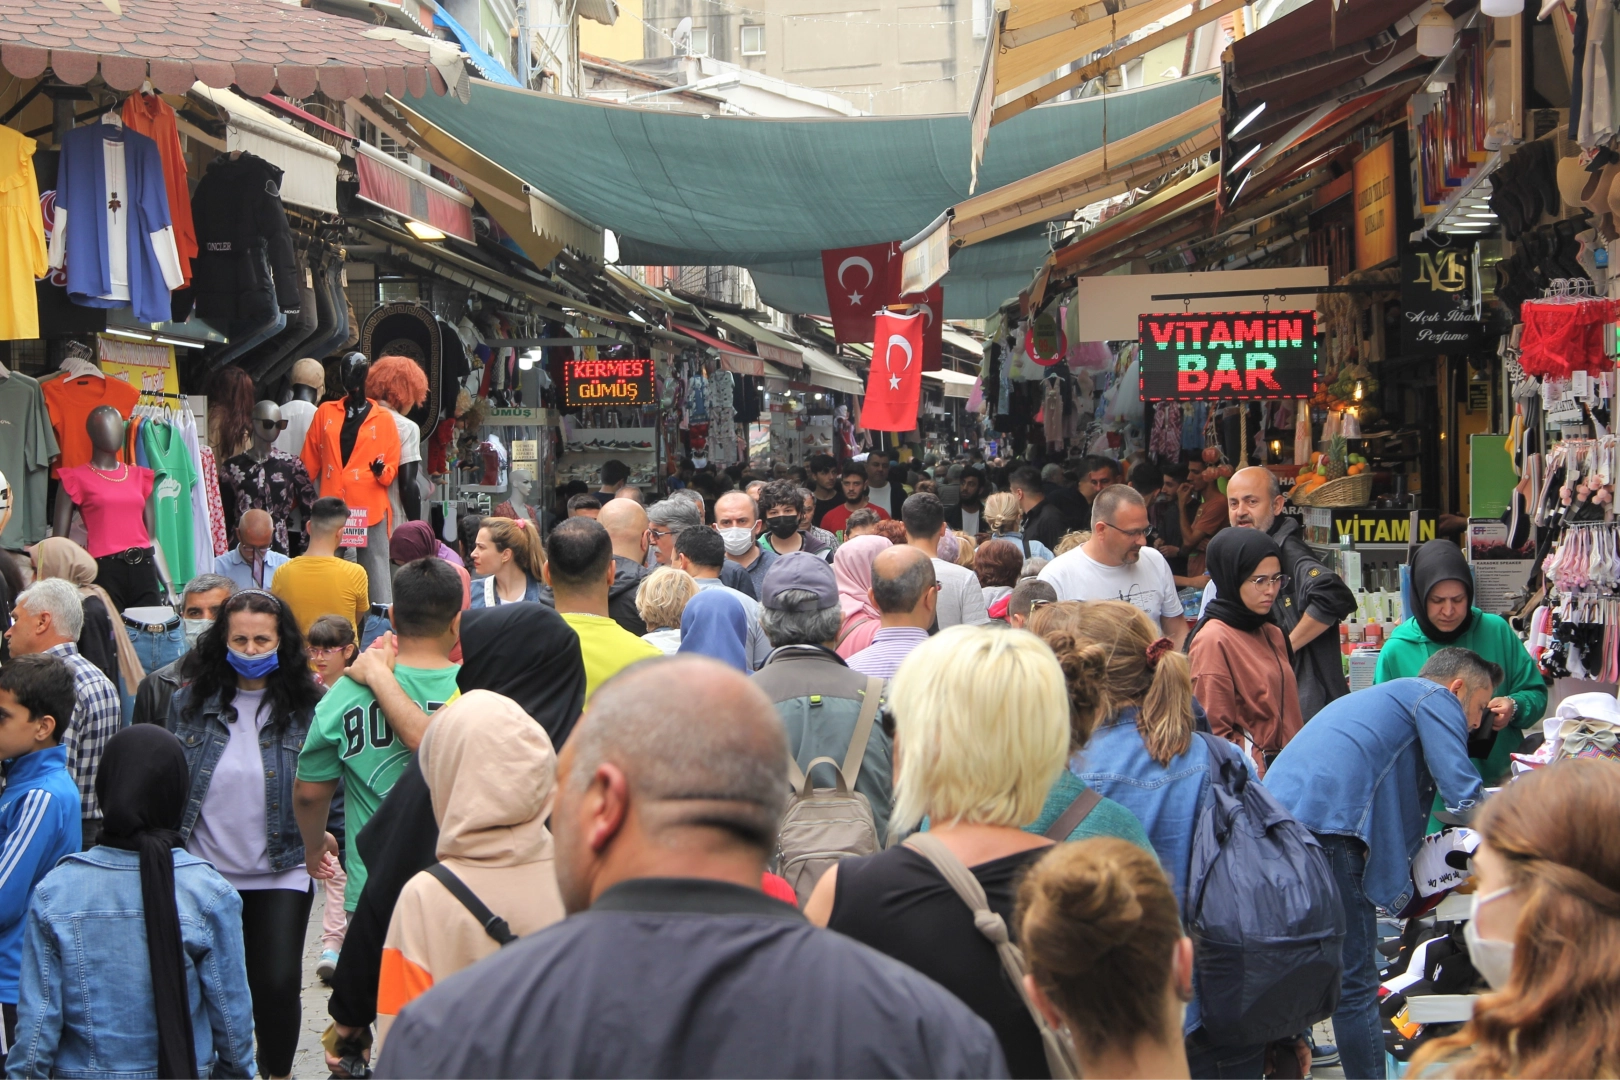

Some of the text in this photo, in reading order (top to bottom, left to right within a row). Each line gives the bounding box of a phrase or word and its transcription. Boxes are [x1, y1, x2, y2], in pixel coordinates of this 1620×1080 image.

[1416, 329, 1469, 344] Perfume
[574, 362, 643, 378] KERMES
[1178, 353, 1282, 392] BAR
[579, 379, 638, 401] GÜMÜŞ
[490, 408, 532, 417] ÜMÜŞ
[1279, 477, 1296, 486] HA
[1335, 514, 1436, 542] VİTAMN
